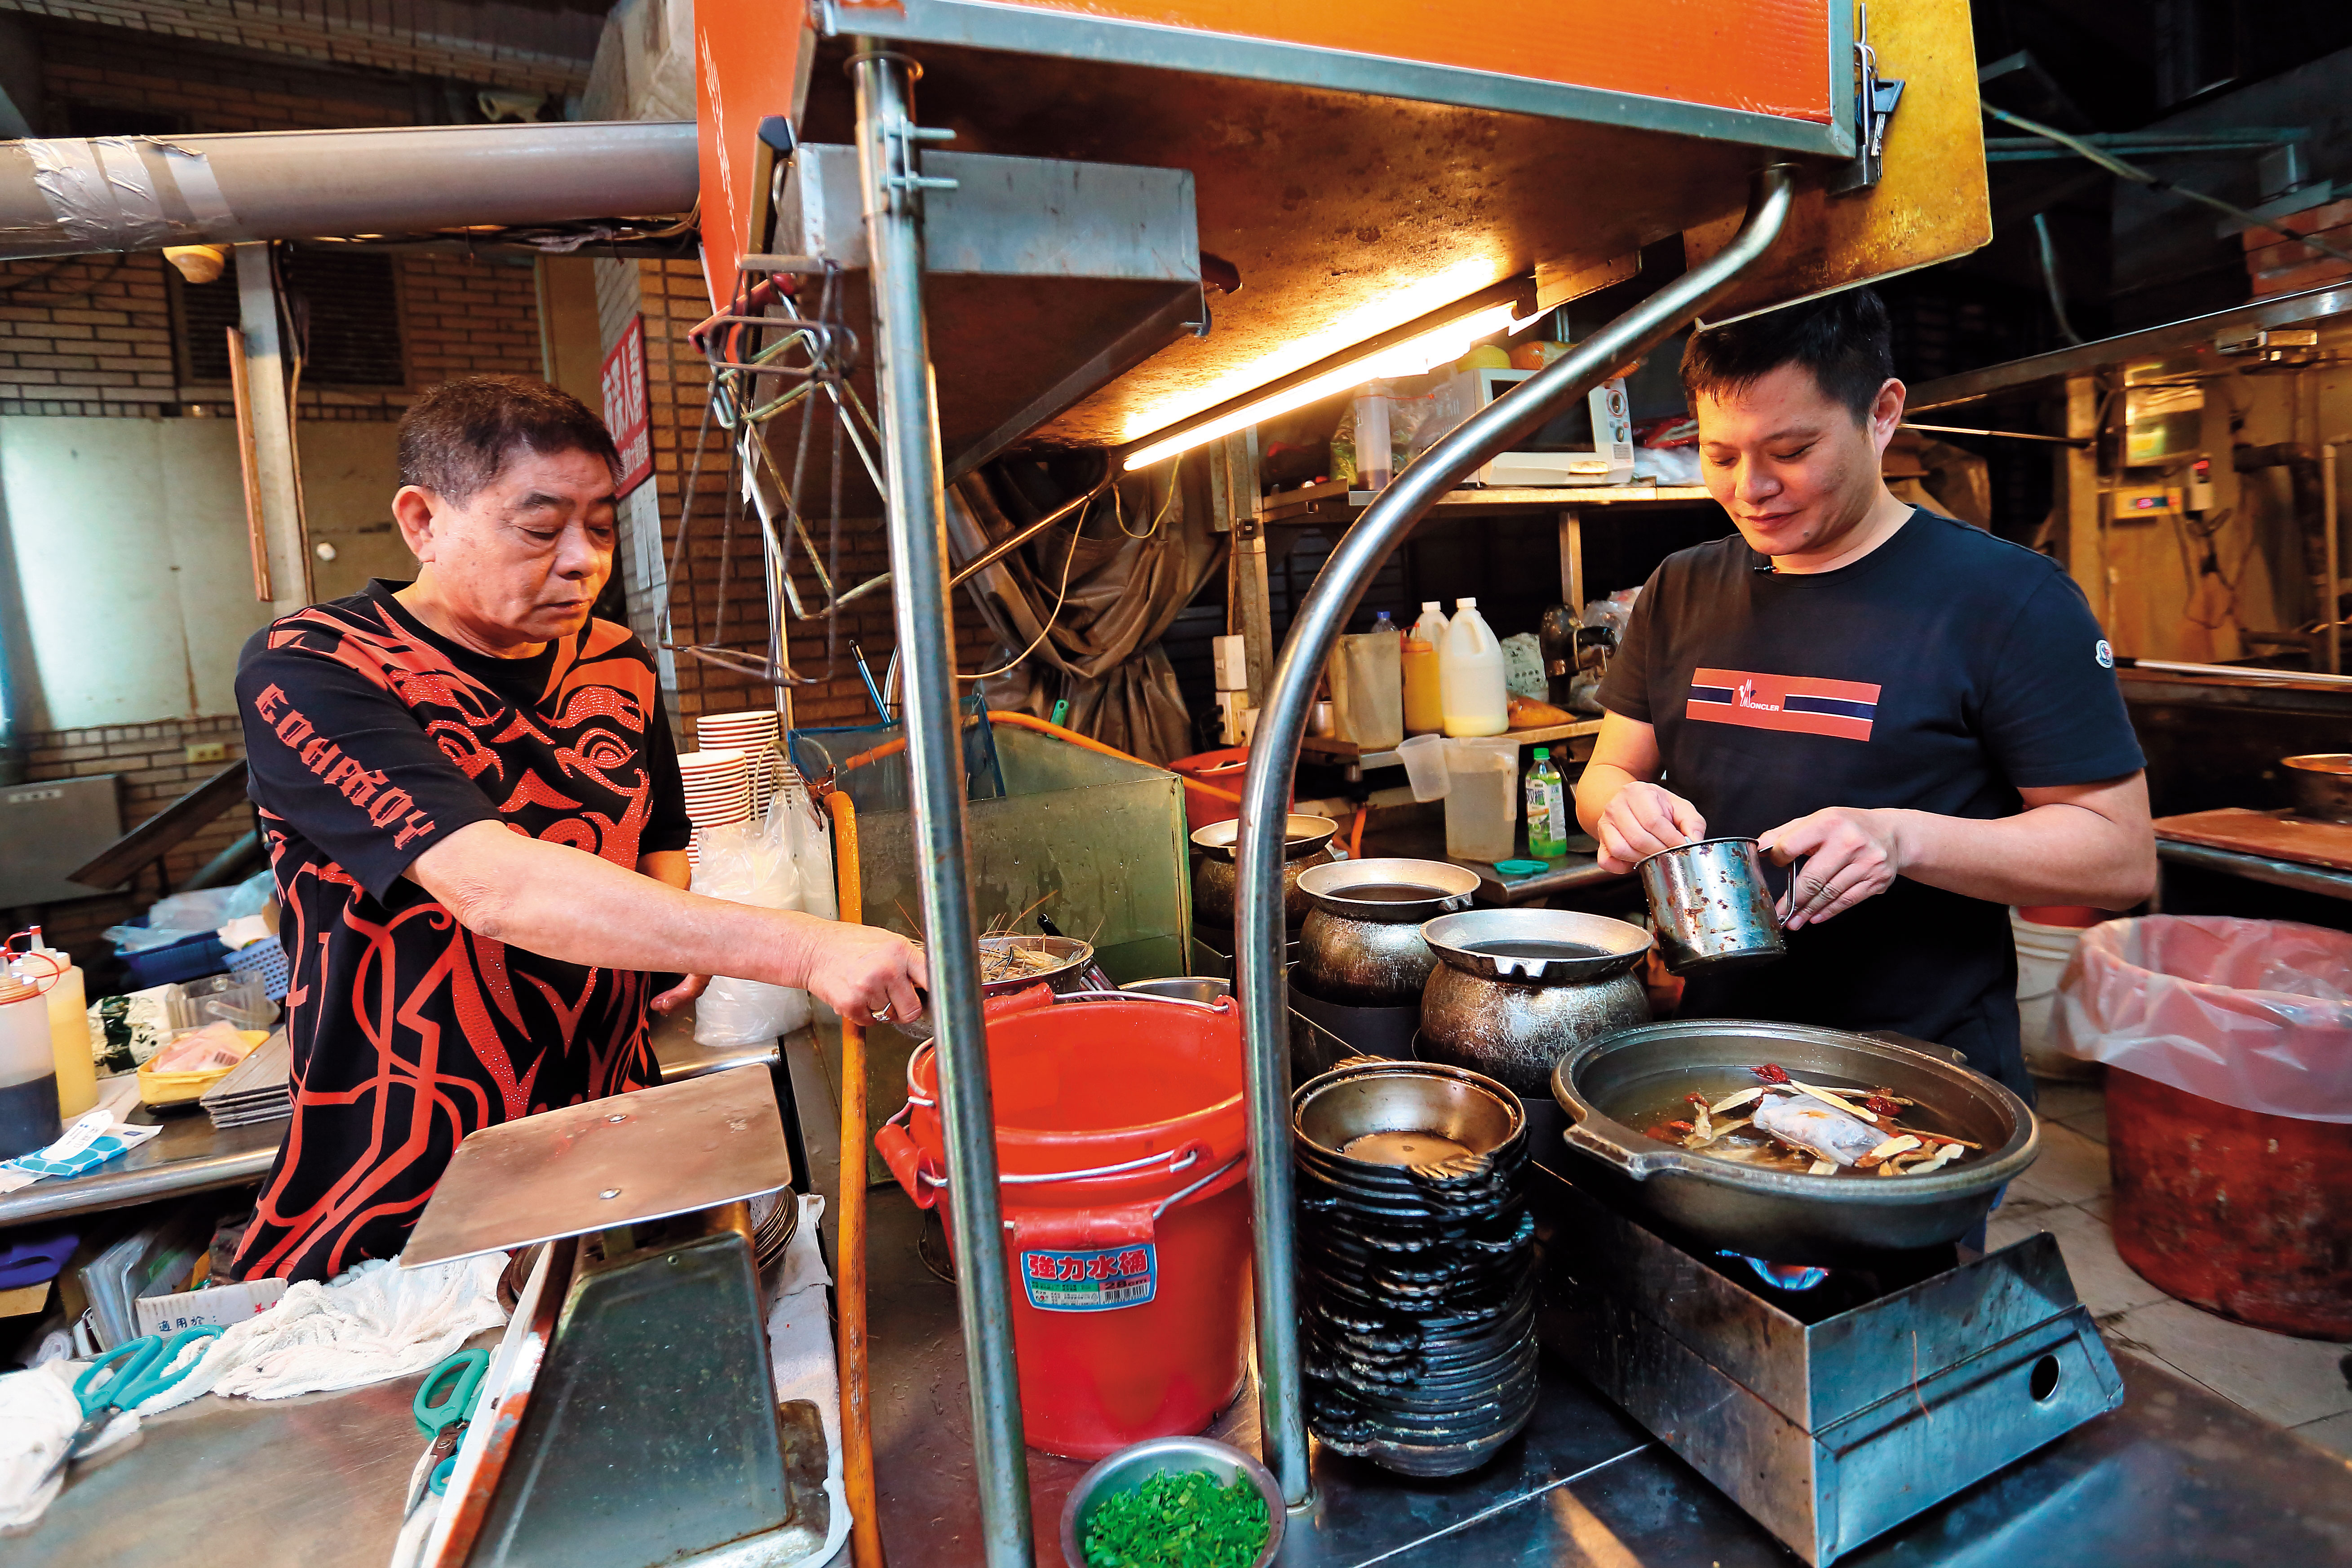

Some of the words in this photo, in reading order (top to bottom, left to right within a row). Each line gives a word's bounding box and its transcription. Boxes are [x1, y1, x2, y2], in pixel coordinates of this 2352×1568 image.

[1740, 679, 1780, 711] MONCLER
[1028, 1249, 1147, 1280] 強力水桶
